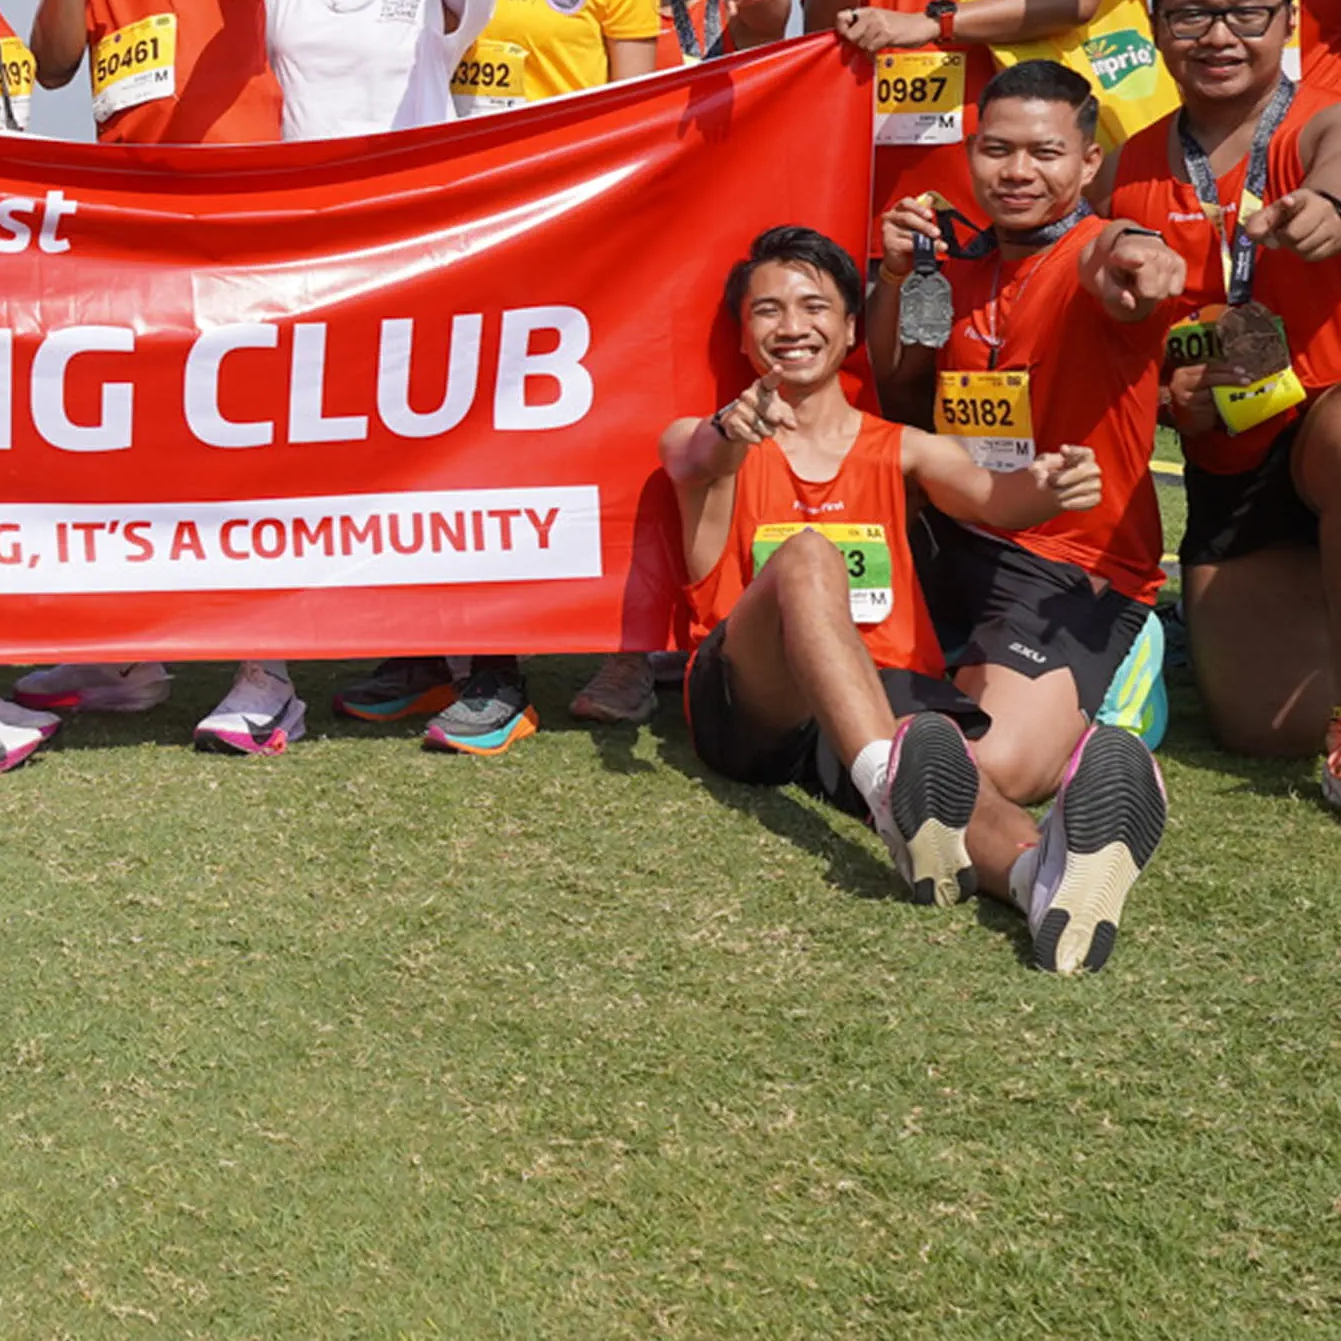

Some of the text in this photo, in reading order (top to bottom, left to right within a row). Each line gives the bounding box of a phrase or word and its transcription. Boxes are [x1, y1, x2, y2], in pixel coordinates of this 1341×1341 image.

[97, 37, 159, 82] 50461
[154, 69, 168, 83] M
[451, 61, 510, 88] 3292
[877, 77, 947, 104] 0987
[938, 115, 955, 129] M
[183, 305, 594, 449] CLUB
[942, 398, 1015, 427] 53182
[1016, 441, 1029, 456] M
[56, 519, 154, 563] IT'S
[170, 520, 206, 561] A
[220, 508, 560, 560] COMMUNITY
[870, 591, 887, 605] M
